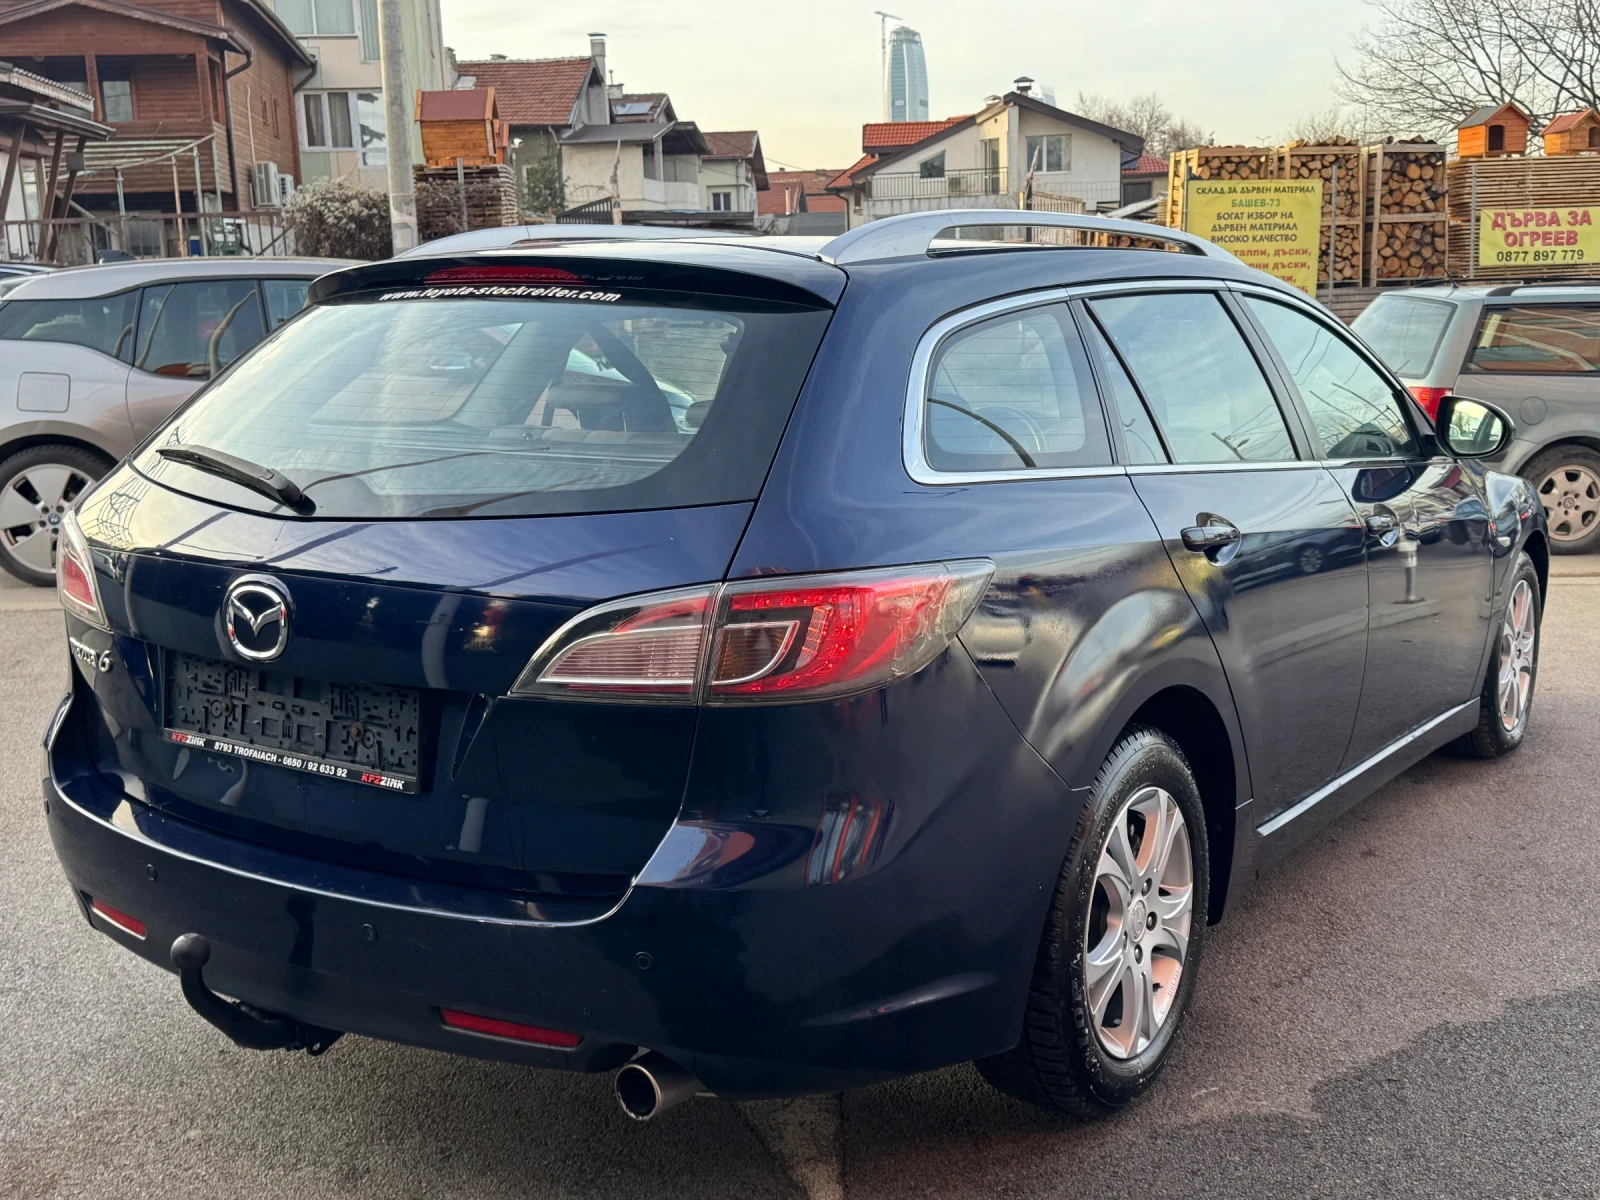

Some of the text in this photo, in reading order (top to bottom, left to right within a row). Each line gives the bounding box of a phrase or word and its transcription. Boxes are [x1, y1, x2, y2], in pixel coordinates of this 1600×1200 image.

[1196, 185, 1315, 195] СКЛАД ЗА ДЪРВЕН МАТЕРИАЛ
[1231, 198, 1281, 208] БАШЕВ-73
[1216, 211, 1294, 221] БОГАТ ИЗБОР НА
[1491, 210, 1592, 231] ДЪРВА ЗА
[1211, 222, 1298, 232] ДЪРВЕН МАТЕРИАЛ
[1211, 234, 1298, 243] ВИСОКО КАЧЕСТВО
[1503, 230, 1579, 247] ОГРЕЕВ
[1273, 248, 1312, 257] дъски,
[1496, 249, 1584, 262] 0877 897 779
[1271, 262, 1311, 271] дъски,
[379, 285, 622, 302] www.toyota-stockreiter.com
[213, 741, 233, 753] 8793
[234, 746, 278, 762] TROFAIACH
[282, 756, 302, 769] 0650
[307, 762, 318, 772] 92
[319, 763, 335, 775] 633
[336, 768, 347, 778] 92
